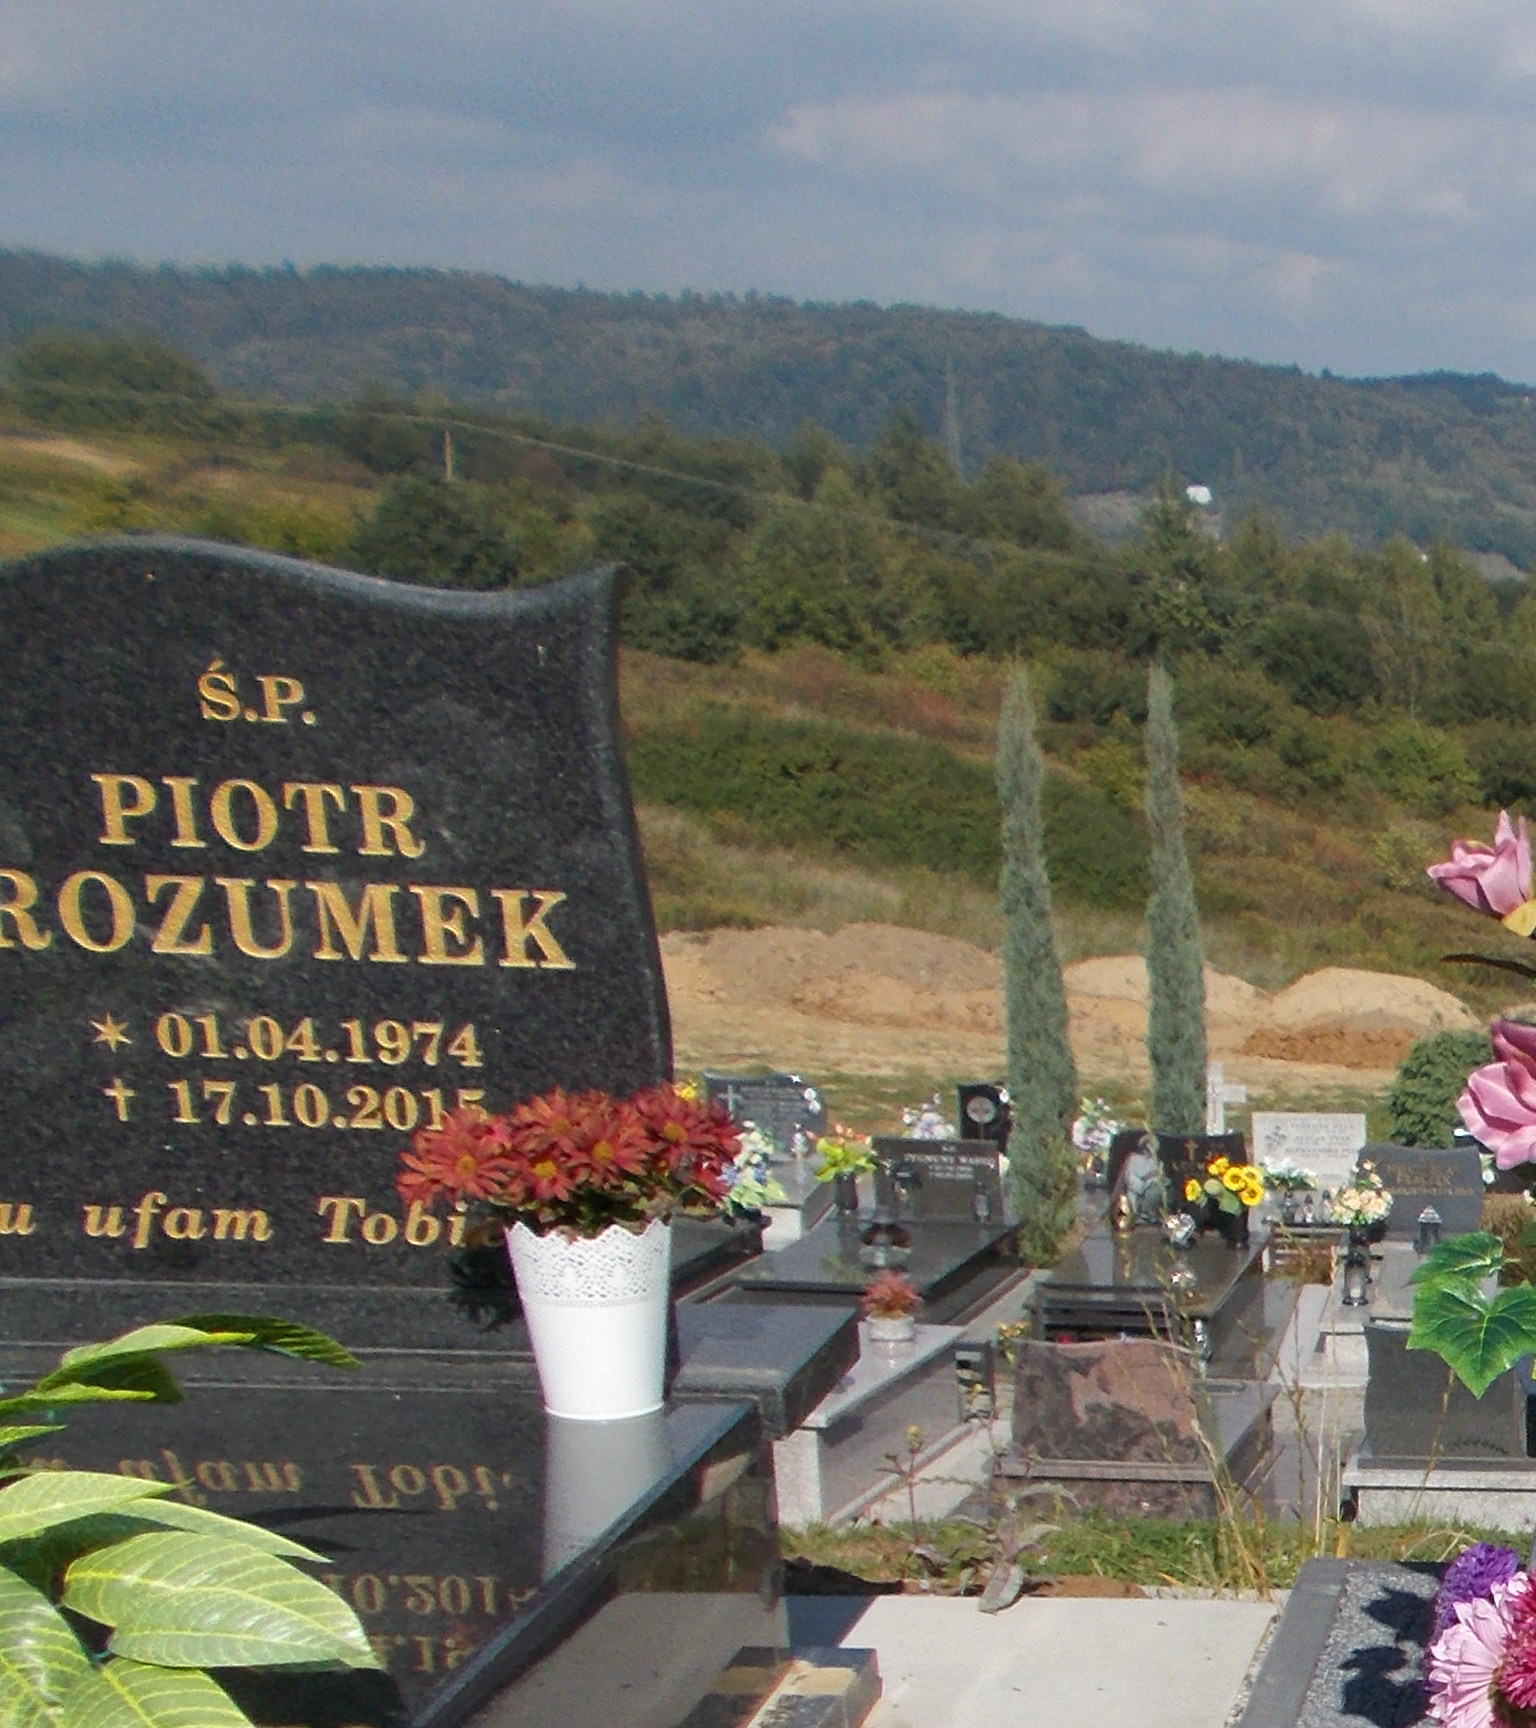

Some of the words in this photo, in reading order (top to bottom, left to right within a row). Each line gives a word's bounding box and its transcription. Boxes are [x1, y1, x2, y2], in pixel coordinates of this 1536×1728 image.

[198, 660, 317, 725] Ś.P.
[91, 773, 426, 860] PIOTR
[0, 867, 577, 971] ROZUMEK
[156, 1013, 485, 1069] 01.04.1974
[83, 1192, 275, 1250] ufam
